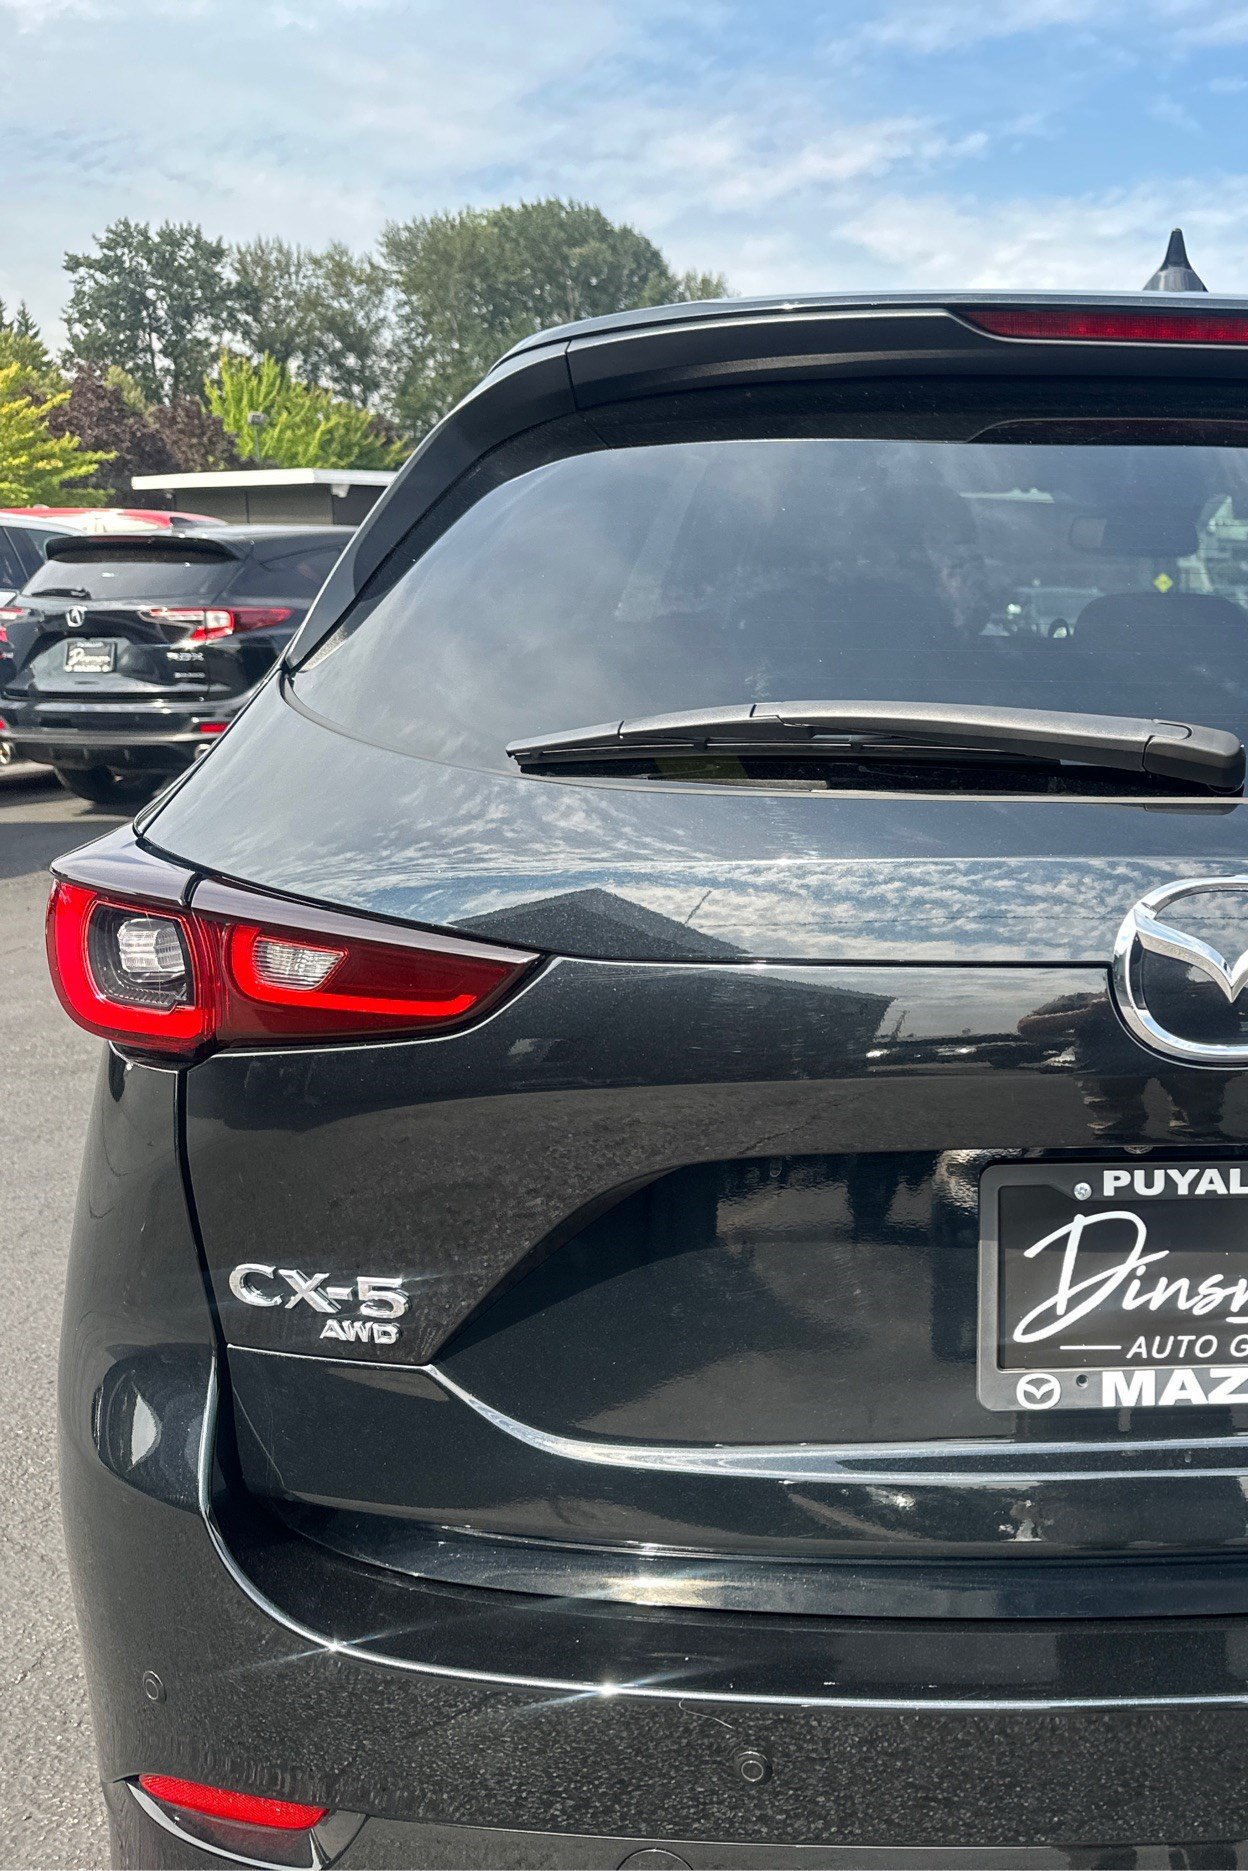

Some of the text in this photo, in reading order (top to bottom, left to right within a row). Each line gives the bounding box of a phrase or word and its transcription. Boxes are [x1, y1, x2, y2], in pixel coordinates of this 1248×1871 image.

[228, 1263, 412, 1319] CX-5
[319, 1318, 402, 1345] AWD
[1126, 1333, 1219, 1359] AUTO
